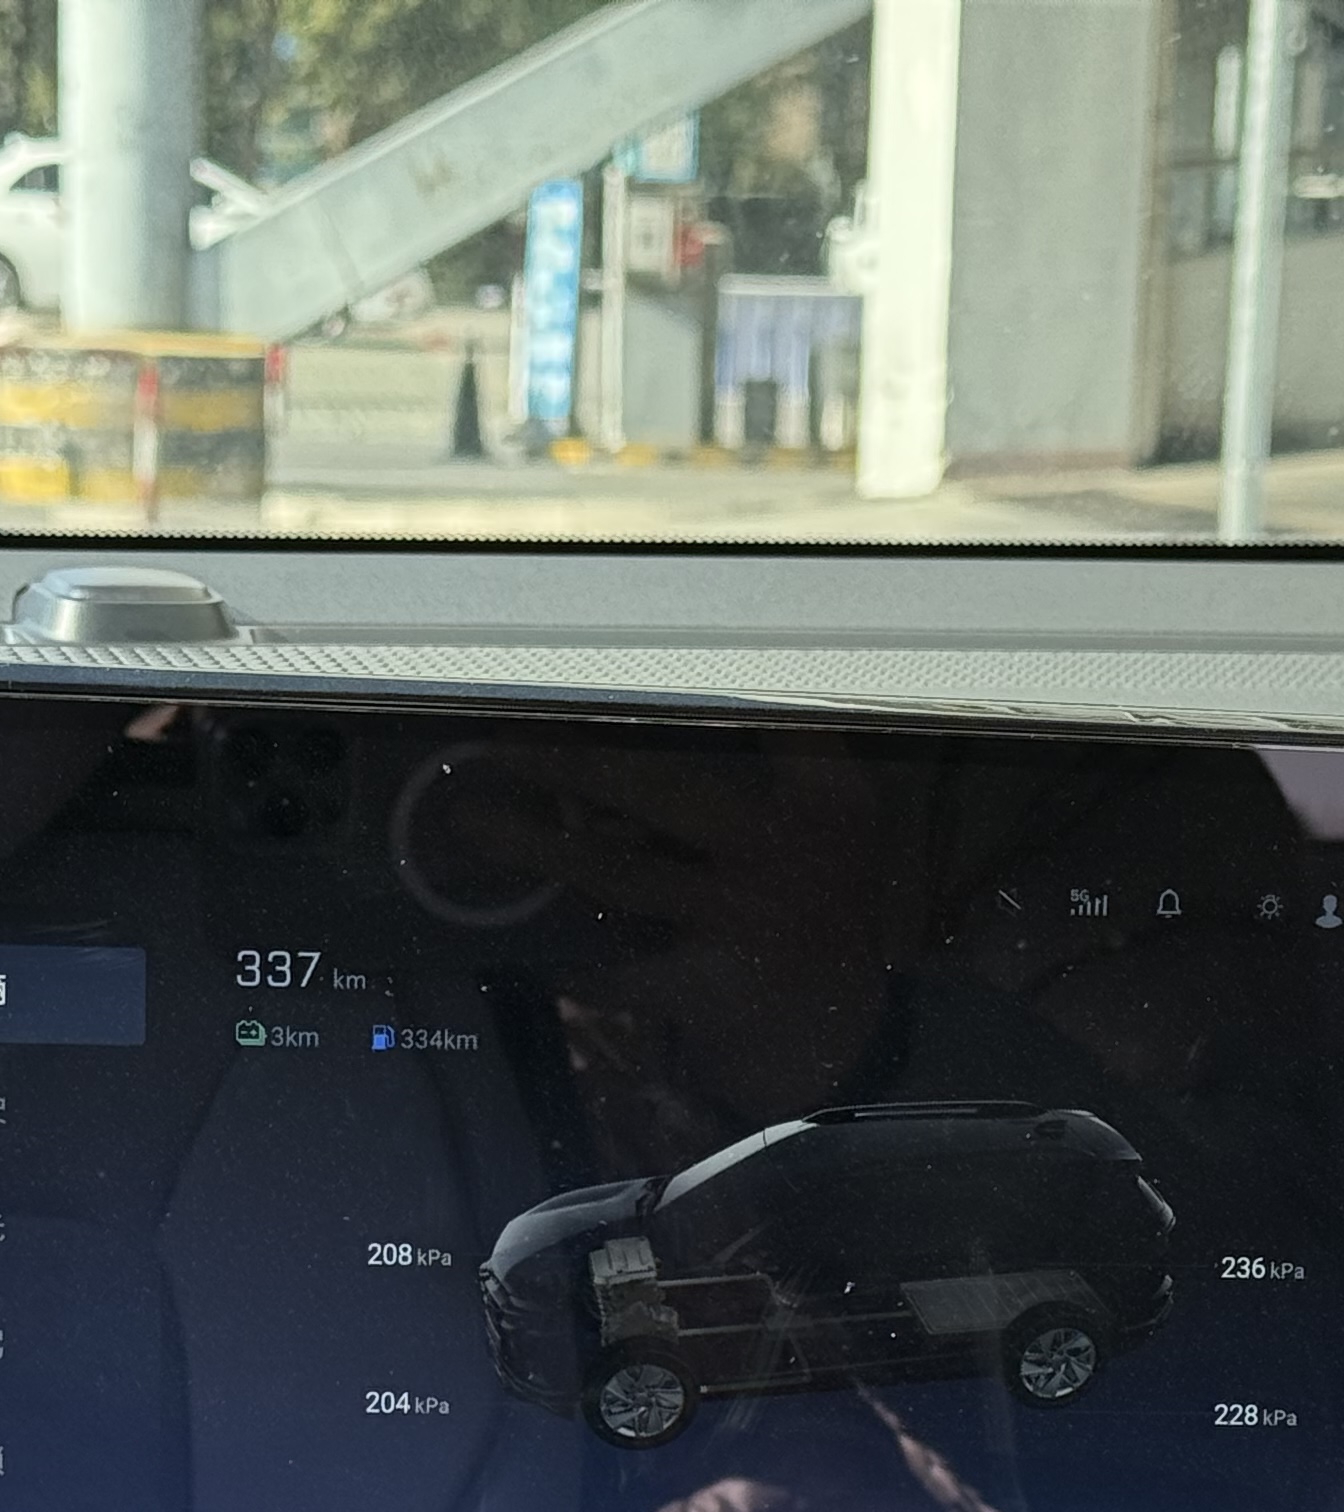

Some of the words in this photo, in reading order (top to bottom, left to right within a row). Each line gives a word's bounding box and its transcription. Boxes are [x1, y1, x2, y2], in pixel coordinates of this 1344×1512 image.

[236, 950, 321, 988] 337
[333, 967, 366, 990] km
[271, 1025, 319, 1047] 3km
[400, 1028, 478, 1050] 334km
[367, 1242, 413, 1266] 208
[417, 1248, 452, 1267] kPa
[1220, 1256, 1266, 1279] 236
[1269, 1261, 1305, 1280] kPa
[365, 1391, 411, 1414] 204
[414, 1396, 450, 1415] kPa
[1214, 1403, 1259, 1426] 228
[1262, 1408, 1297, 1427] kPa
